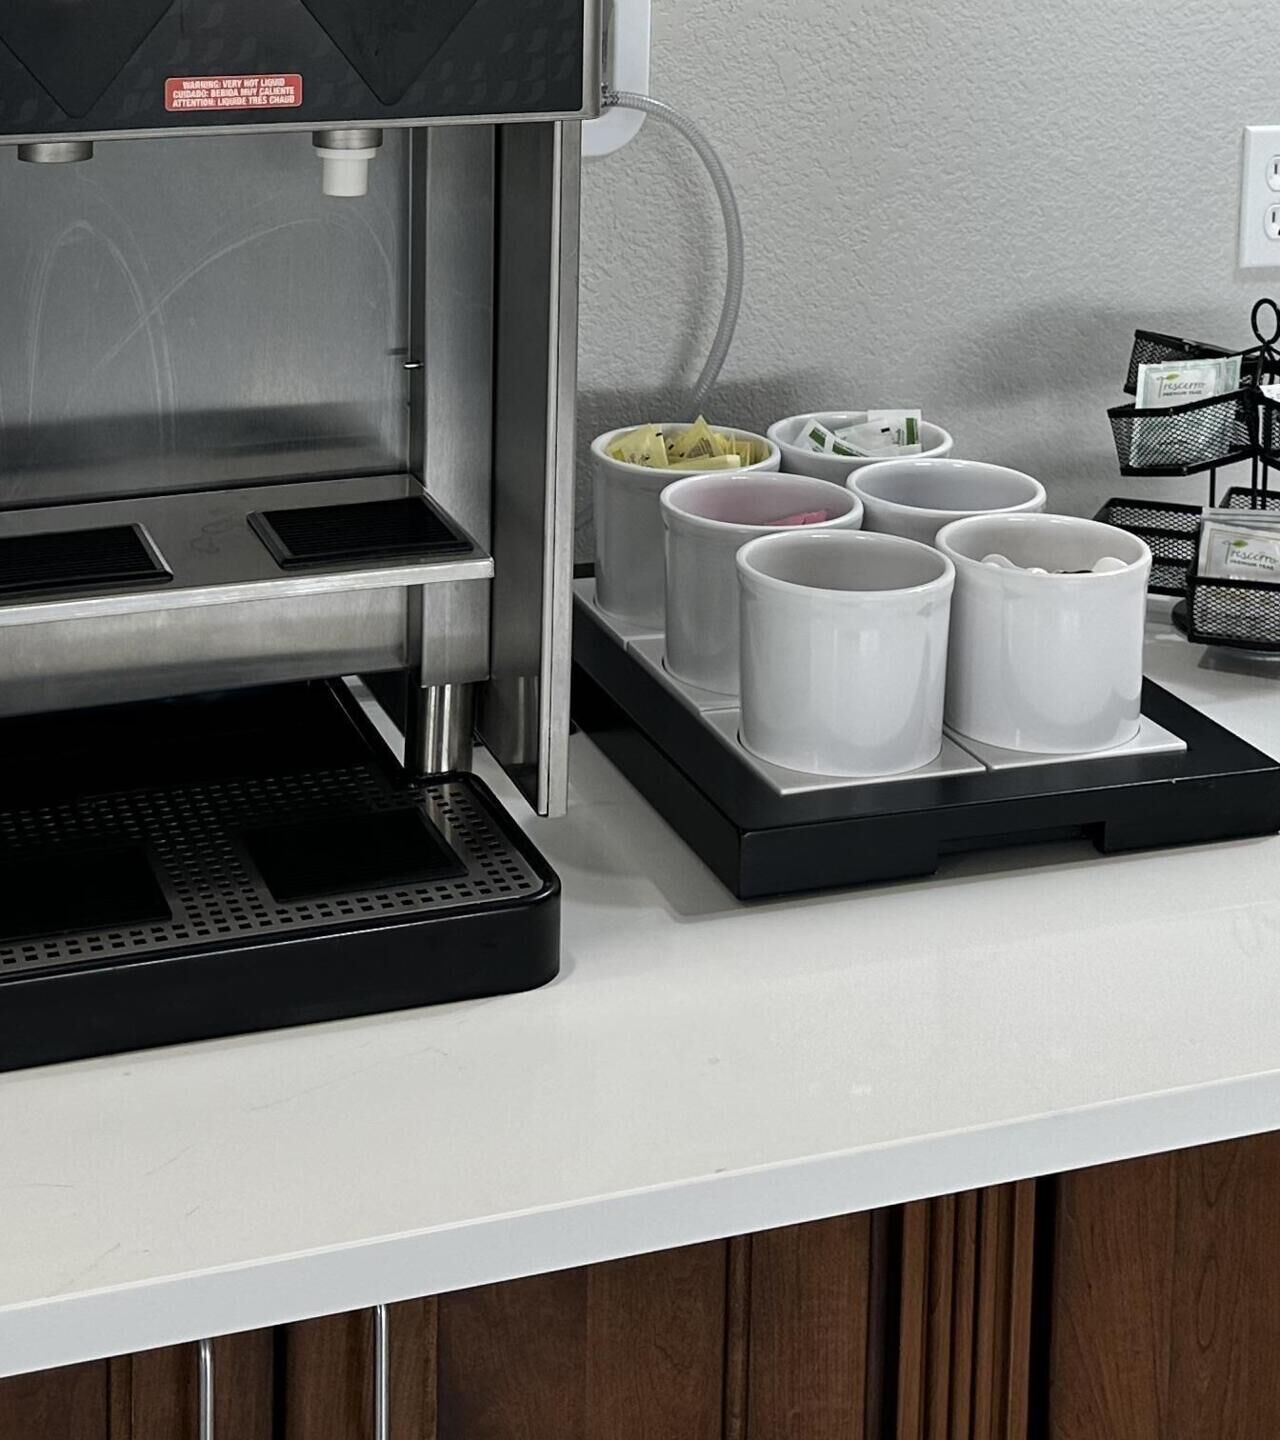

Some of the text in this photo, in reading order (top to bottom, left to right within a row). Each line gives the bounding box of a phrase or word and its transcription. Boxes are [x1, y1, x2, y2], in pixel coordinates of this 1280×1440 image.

[182, 78, 286, 90] WARNING: VERY HOT LIQUID
[172, 86, 295, 99] CUIDADO: BEBIDA MUY CALIENTE
[172, 98, 217, 108] ATTENTION:
[217, 96, 247, 107] LIQUIDE
[268, 94, 295, 105] CHAUD
